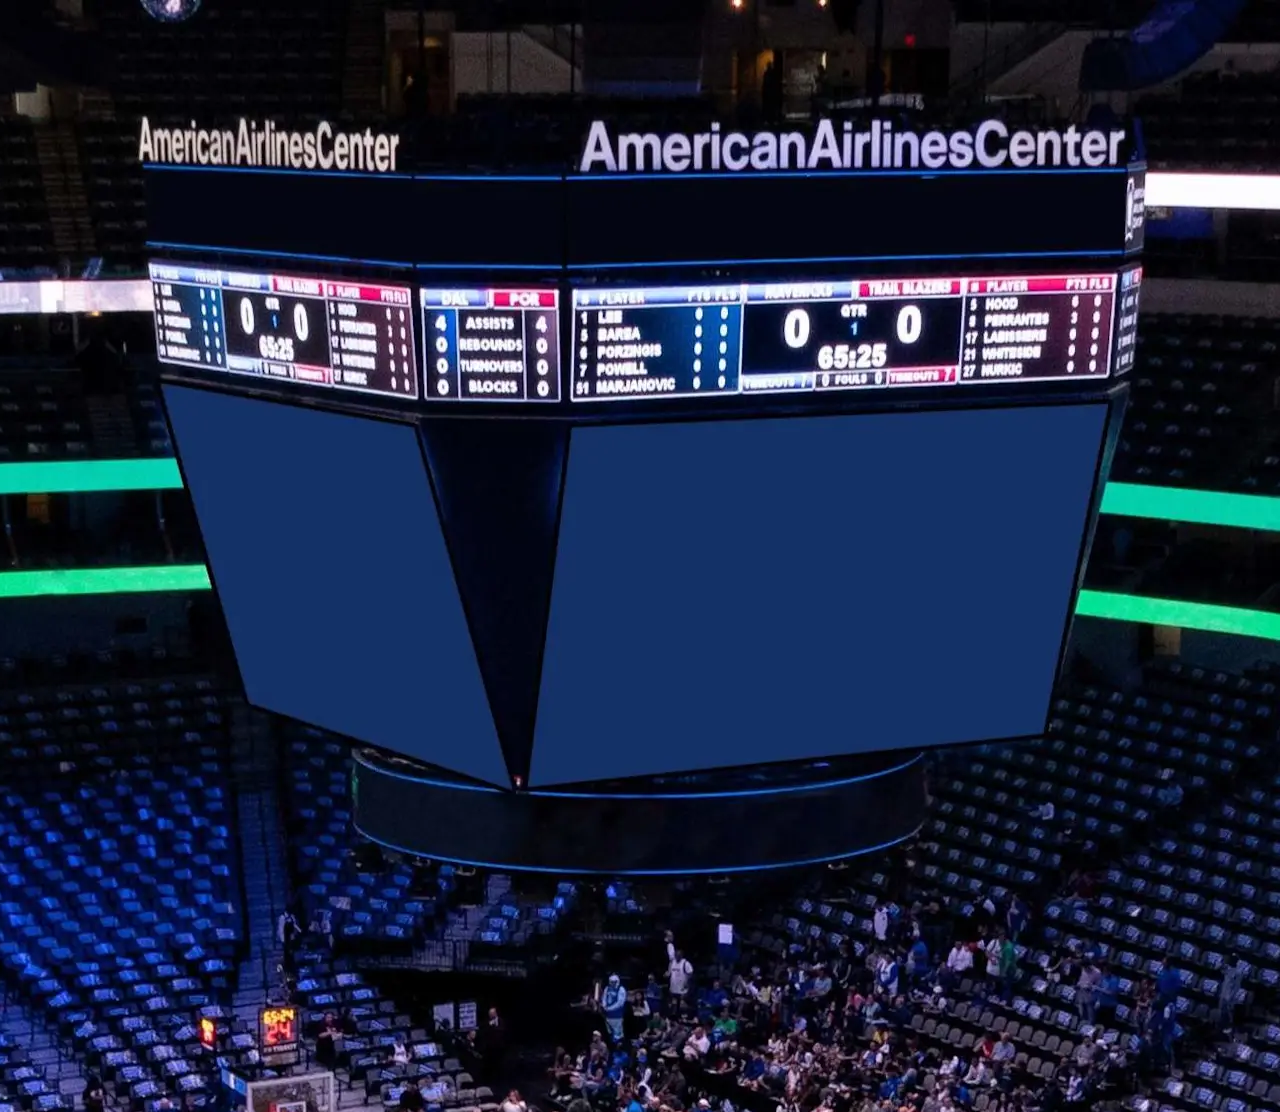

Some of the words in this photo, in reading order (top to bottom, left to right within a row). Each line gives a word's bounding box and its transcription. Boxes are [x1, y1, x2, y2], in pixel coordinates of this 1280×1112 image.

[869, 283, 899, 296] TRAIL
[986, 280, 1029, 293] PLAYER
[1066, 278, 1087, 290] PTS
[509, 292, 540, 306] POR
[985, 297, 1018, 311] HOOD
[581, 311, 588, 325] 1
[840, 304, 868, 318] QTR
[240, 297, 255, 335] 0
[293, 302, 309, 342] 0
[435, 315, 447, 331] 4
[465, 317, 515, 330] ASSISTS
[535, 315, 548, 333] 4
[783, 308, 810, 348] 0
[896, 305, 922, 344] 0
[984, 312, 1050, 327] PERRANTES
[850, 322, 858, 336] 1
[436, 336, 448, 353] 0
[460, 338, 523, 351] REBOUNDS
[536, 337, 548, 354] 0
[965, 331, 978, 345] 17
[259, 335, 294, 361] 65:25
[597, 343, 662, 359] PORZINGIS
[964, 348, 976, 362] 21
[817, 343, 887, 370] 65:25
[436, 357, 449, 374] 0
[460, 359, 523, 373] TURNOVERS
[537, 359, 549, 375] 0
[579, 363, 588, 378] 7
[596, 361, 648, 377] POWELL
[963, 364, 976, 378] 27
[981, 362, 1023, 377] NURKIC
[576, 381, 589, 395] 51
[595, 377, 676, 394] MARJANOVIC
[821, 373, 830, 387] 0
[835, 373, 868, 385] FOULS
[874, 371, 882, 385] 0
[437, 378, 449, 395] 0
[468, 379, 518, 393] BLOCKS
[537, 380, 549, 397] 0
[263, 1009, 294, 1024] 65:24
[266, 1022, 291, 1043] 24
